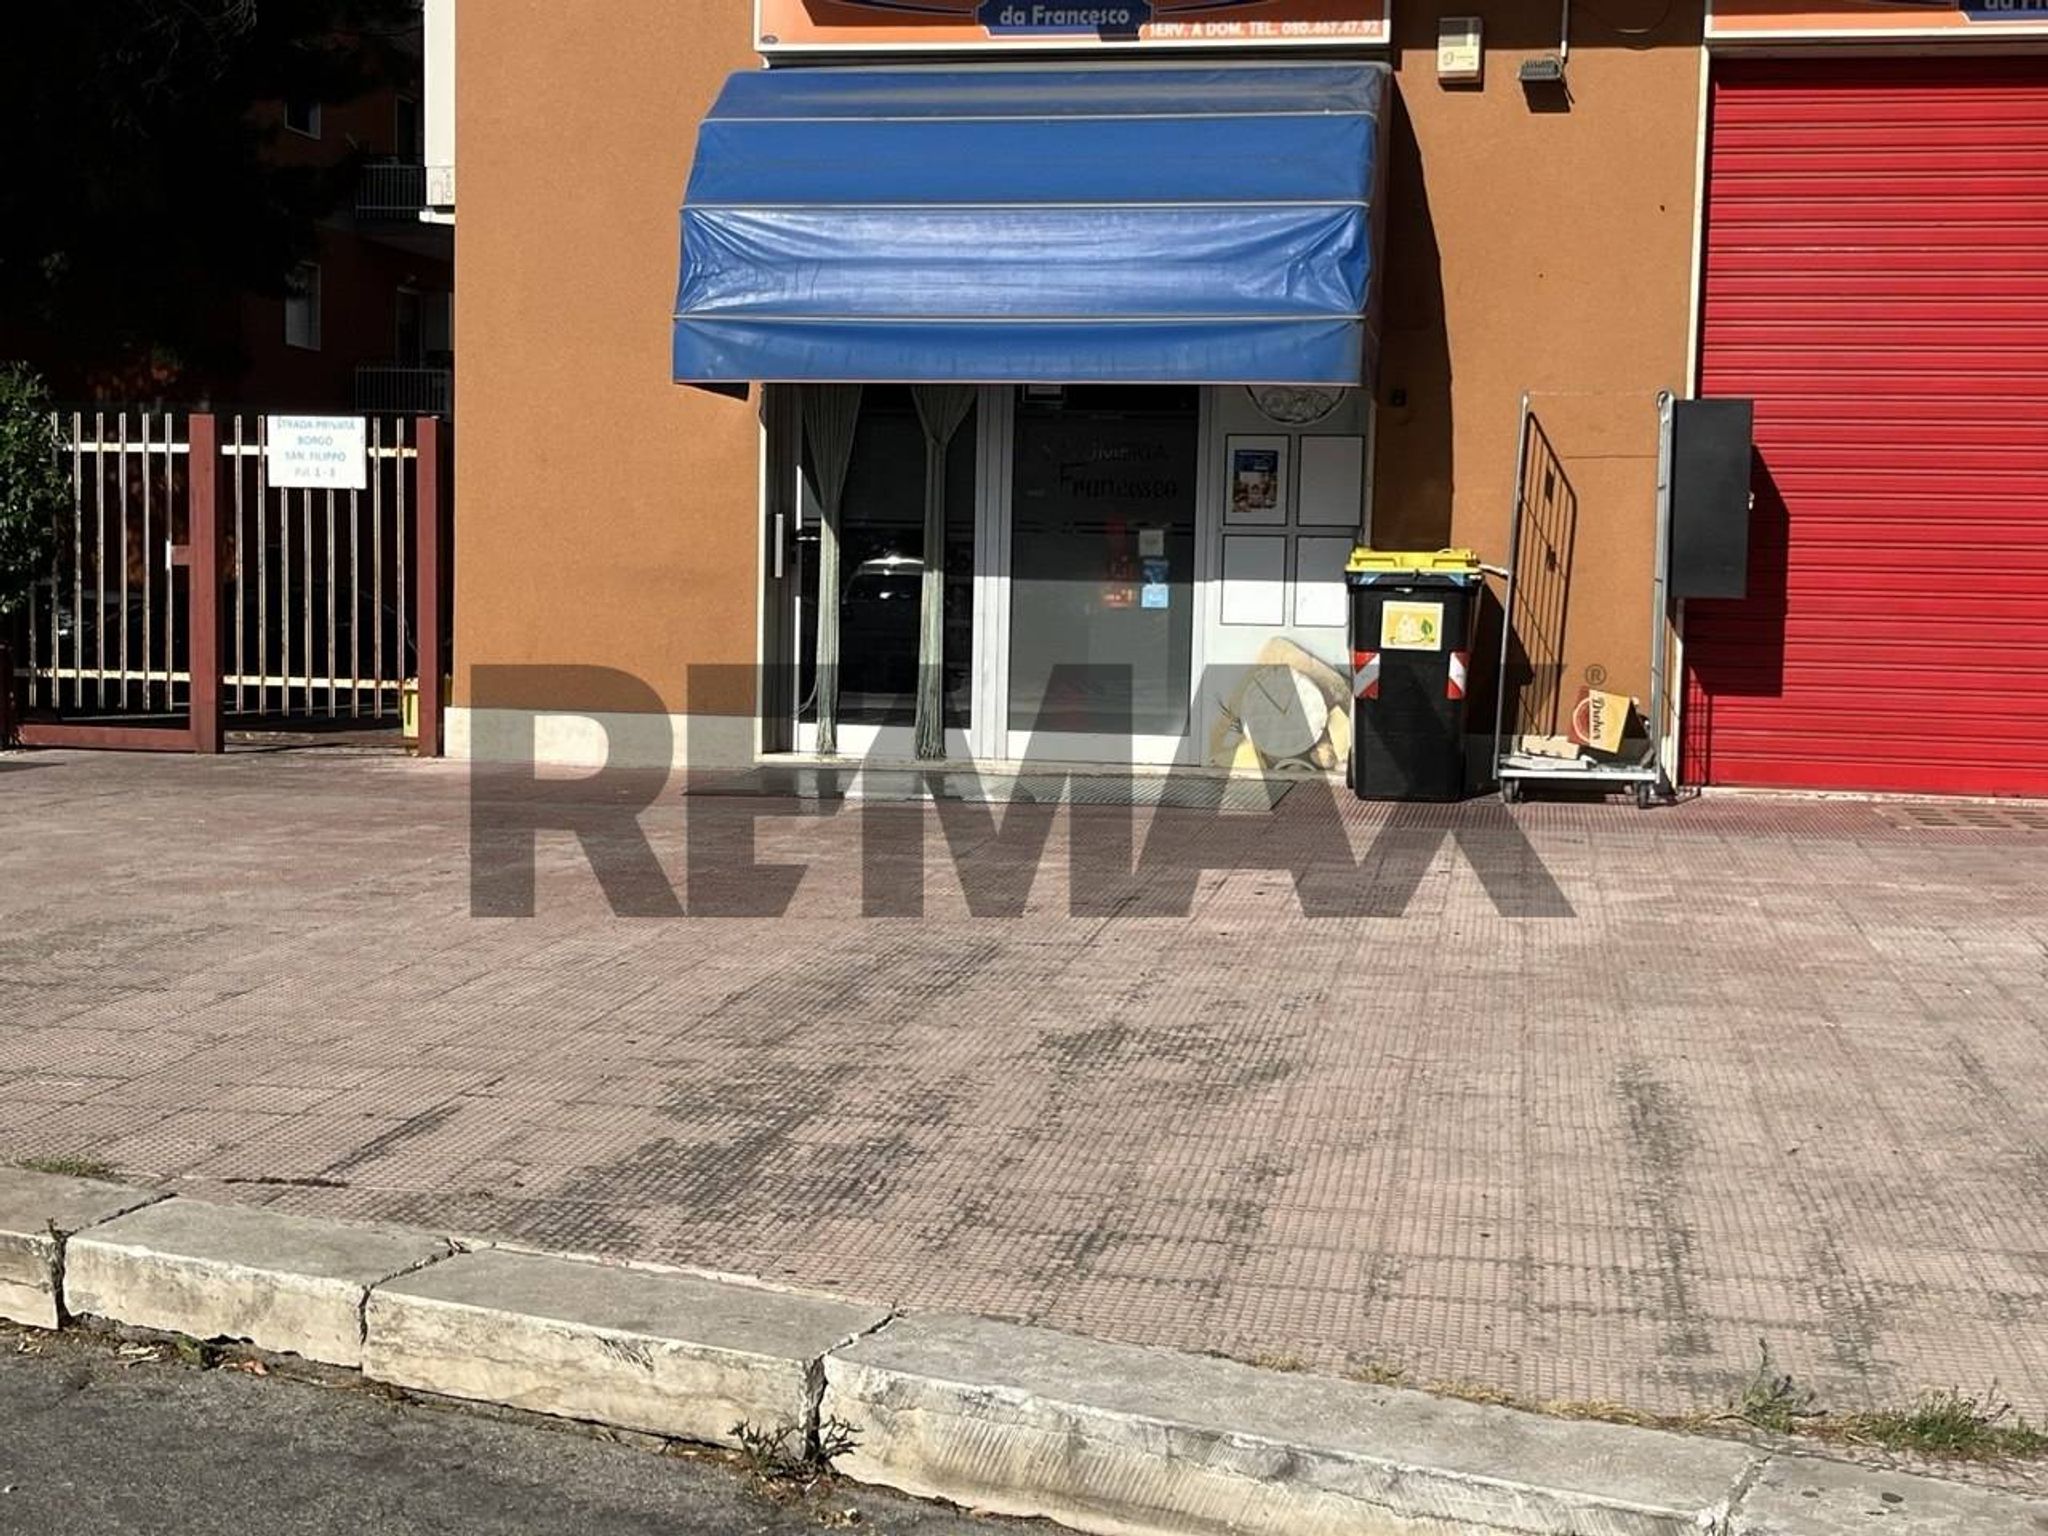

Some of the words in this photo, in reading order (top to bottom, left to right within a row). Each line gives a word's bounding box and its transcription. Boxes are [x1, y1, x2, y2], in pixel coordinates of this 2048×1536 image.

[999, 5, 1026, 25] da
[1031, 4, 1131, 26] Francesco
[1191, 23, 1204, 37] A
[1205, 23, 1242, 37] DOM.
[1248, 22, 1281, 36] TEL.
[277, 419, 313, 430] STRADA
[298, 436, 334, 447] BORGO
[309, 451, 347, 462] FILIPPO
